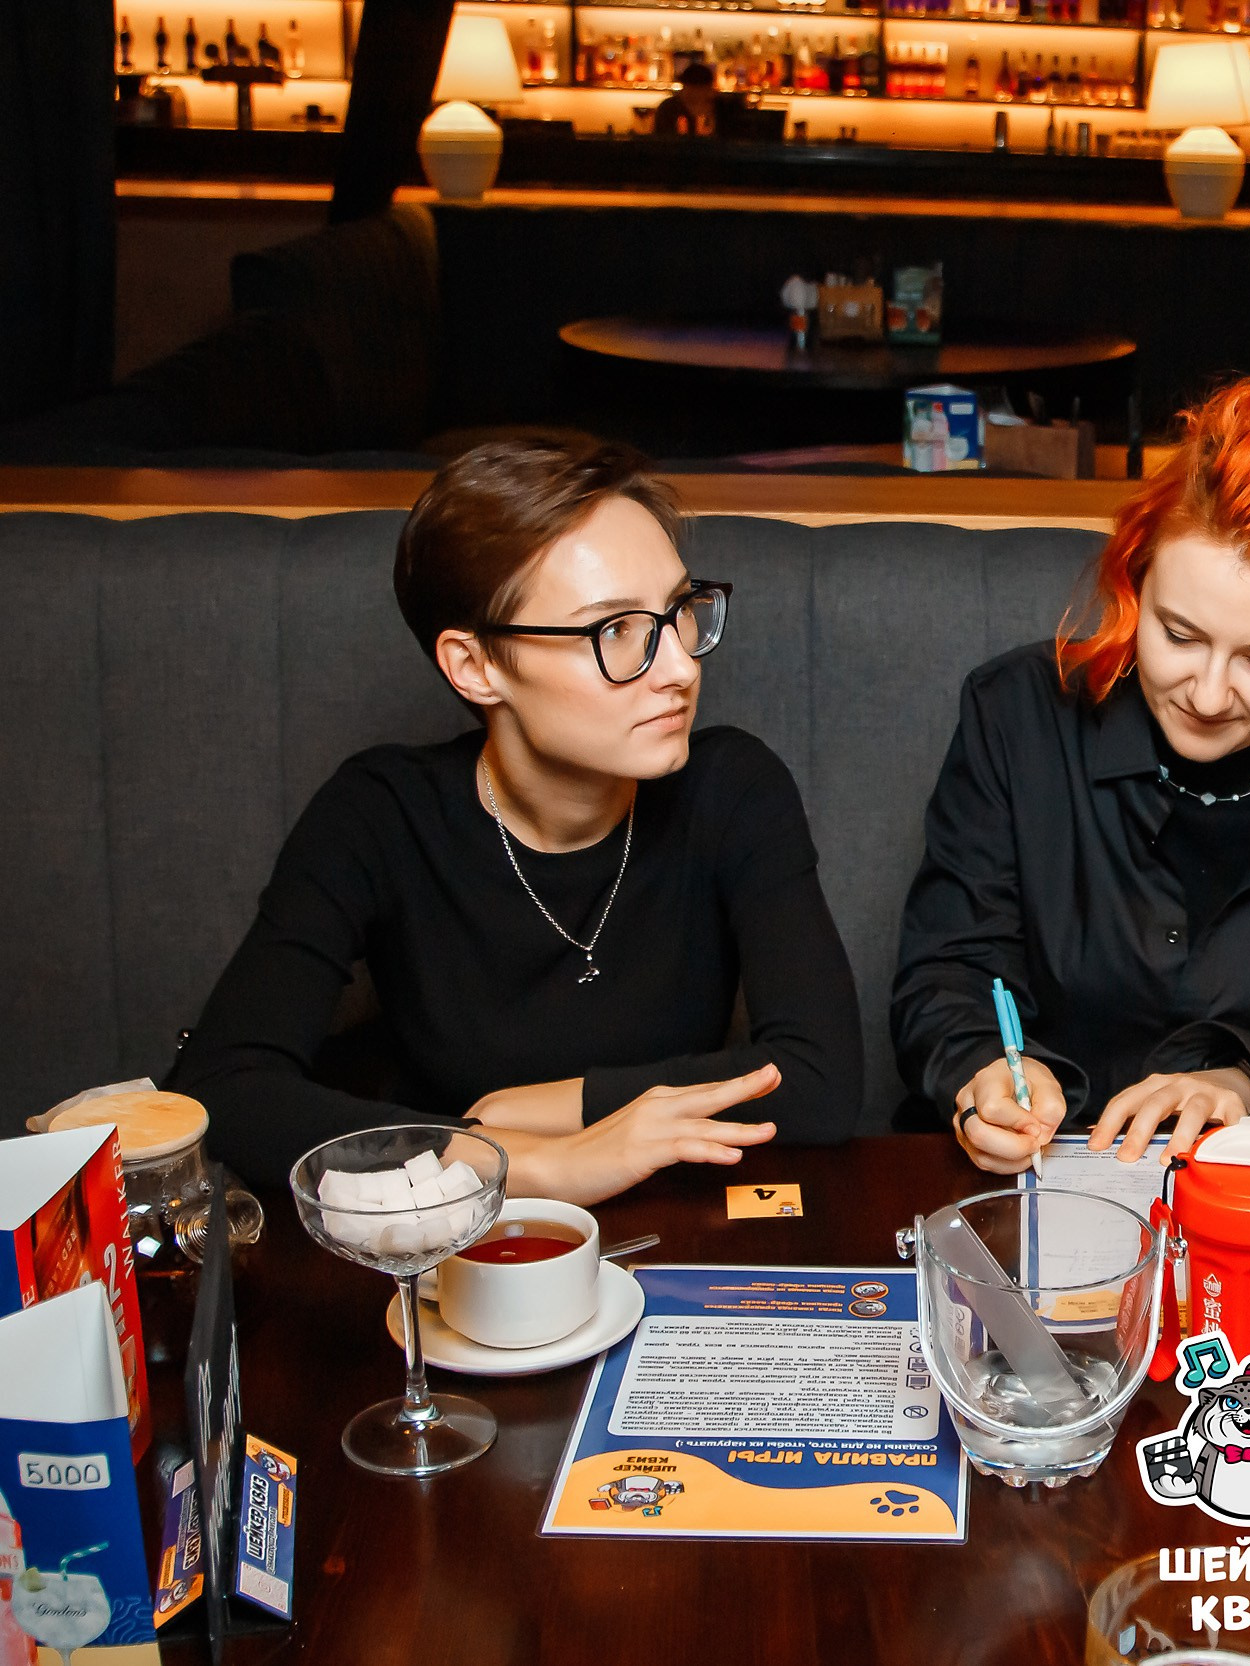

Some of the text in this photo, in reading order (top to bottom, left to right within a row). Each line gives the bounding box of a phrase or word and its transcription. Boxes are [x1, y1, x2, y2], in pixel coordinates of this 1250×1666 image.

[753, 1188, 777, 1201] 4
[112, 1141, 135, 1279] WALKER
[685, 1439, 746, 1448] нарушать
[767, 1441, 806, 1449] чтобы
[809, 1440, 838, 1449] того,
[841, 1441, 864, 1450] для
[884, 1443, 938, 1451] Созданы
[626, 1455, 669, 1464] КВИЗ
[727, 1450, 938, 1467] ПРАВИЛА ИГРЫ
[613, 1464, 678, 1473] ШЕЙКЕР
[26, 1461, 103, 1487] 5000
[243, 1475, 268, 1559] ШЕЙКЕР КВИЗ
